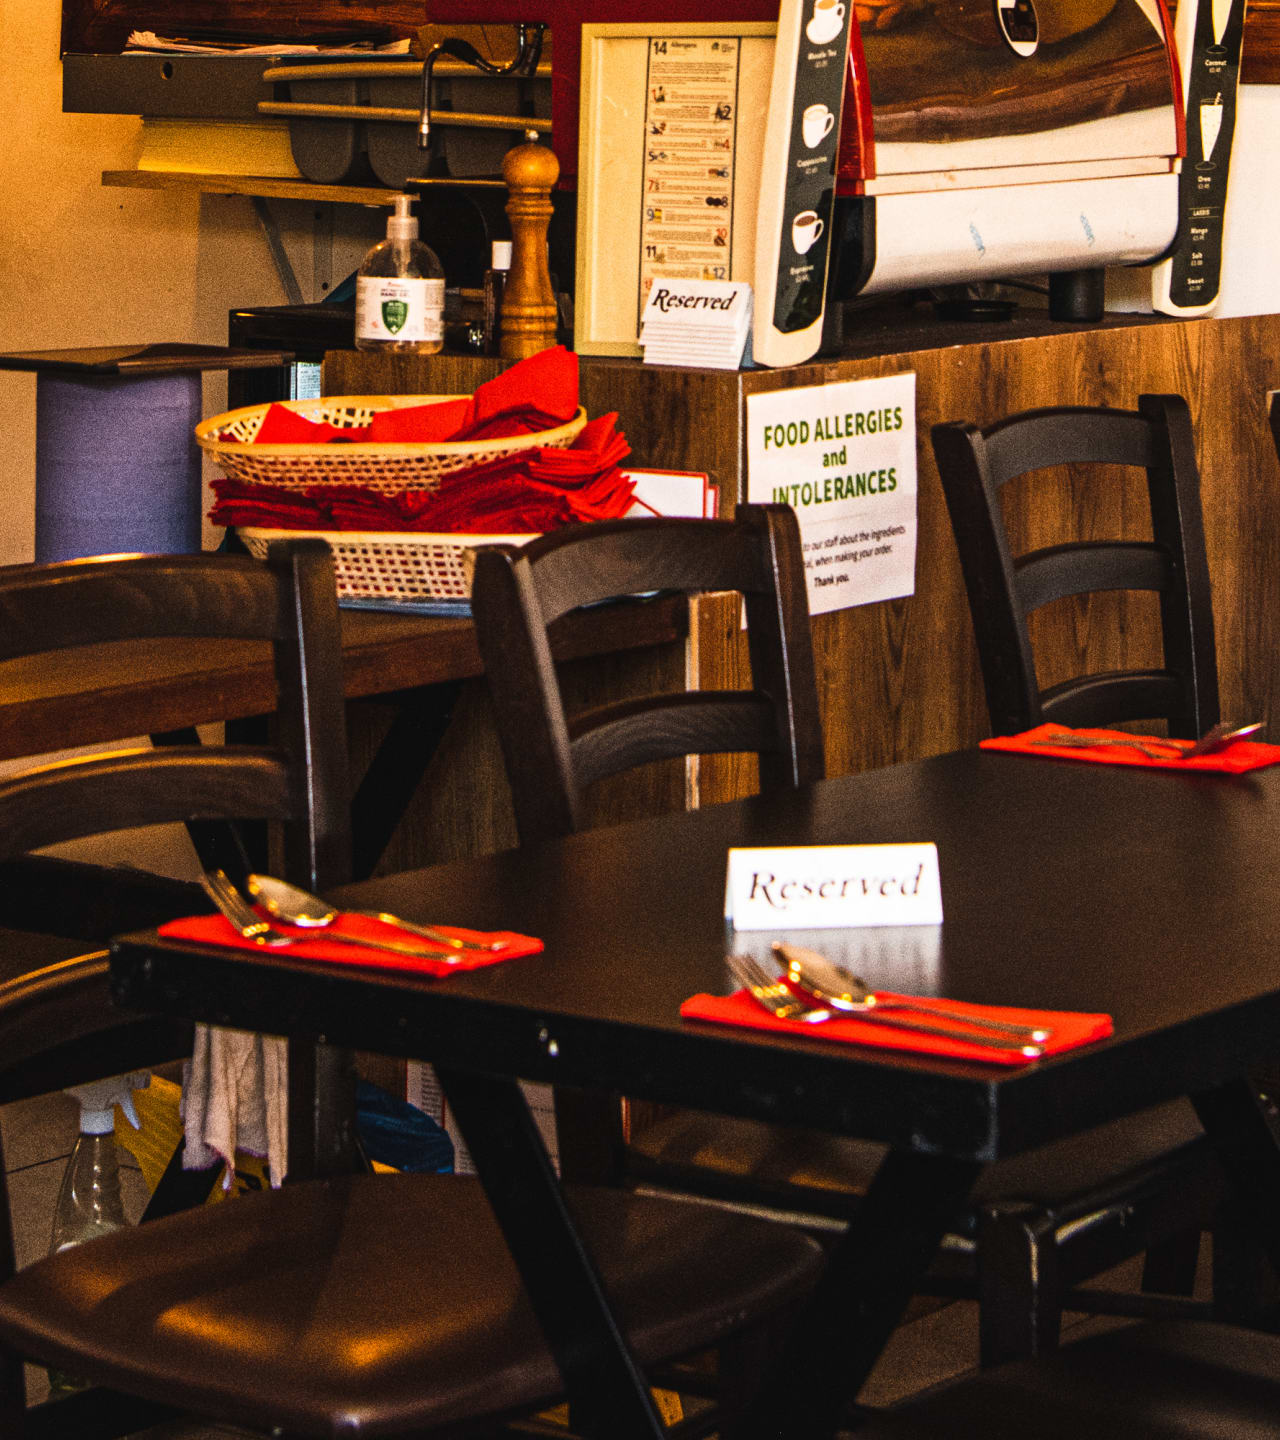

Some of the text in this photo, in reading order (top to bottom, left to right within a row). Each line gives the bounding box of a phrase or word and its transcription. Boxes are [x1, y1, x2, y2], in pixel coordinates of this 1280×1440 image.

[654, 41, 668, 55] 14
[720, 104, 733, 121] 2
[648, 151, 656, 162] 5
[721, 167, 730, 178] 6
[648, 179, 656, 191] 7
[720, 196, 729, 208] 8
[646, 208, 655, 222] 9
[645, 245, 657, 258] 11
[713, 266, 726, 280] 12
[651, 288, 738, 313] Reserved
[763, 406, 903, 450] FOOD ALLERGIES
[822, 444, 848, 468] and
[771, 467, 898, 510] INTOLERANCES
[812, 540, 824, 552] our
[839, 532, 859, 547] about
[859, 528, 871, 543] the
[871, 524, 907, 543] ingredients
[834, 548, 859, 566] making
[859, 549, 874, 564] your
[814, 574, 835, 589] Thank
[749, 863, 924, 910] Reserved
